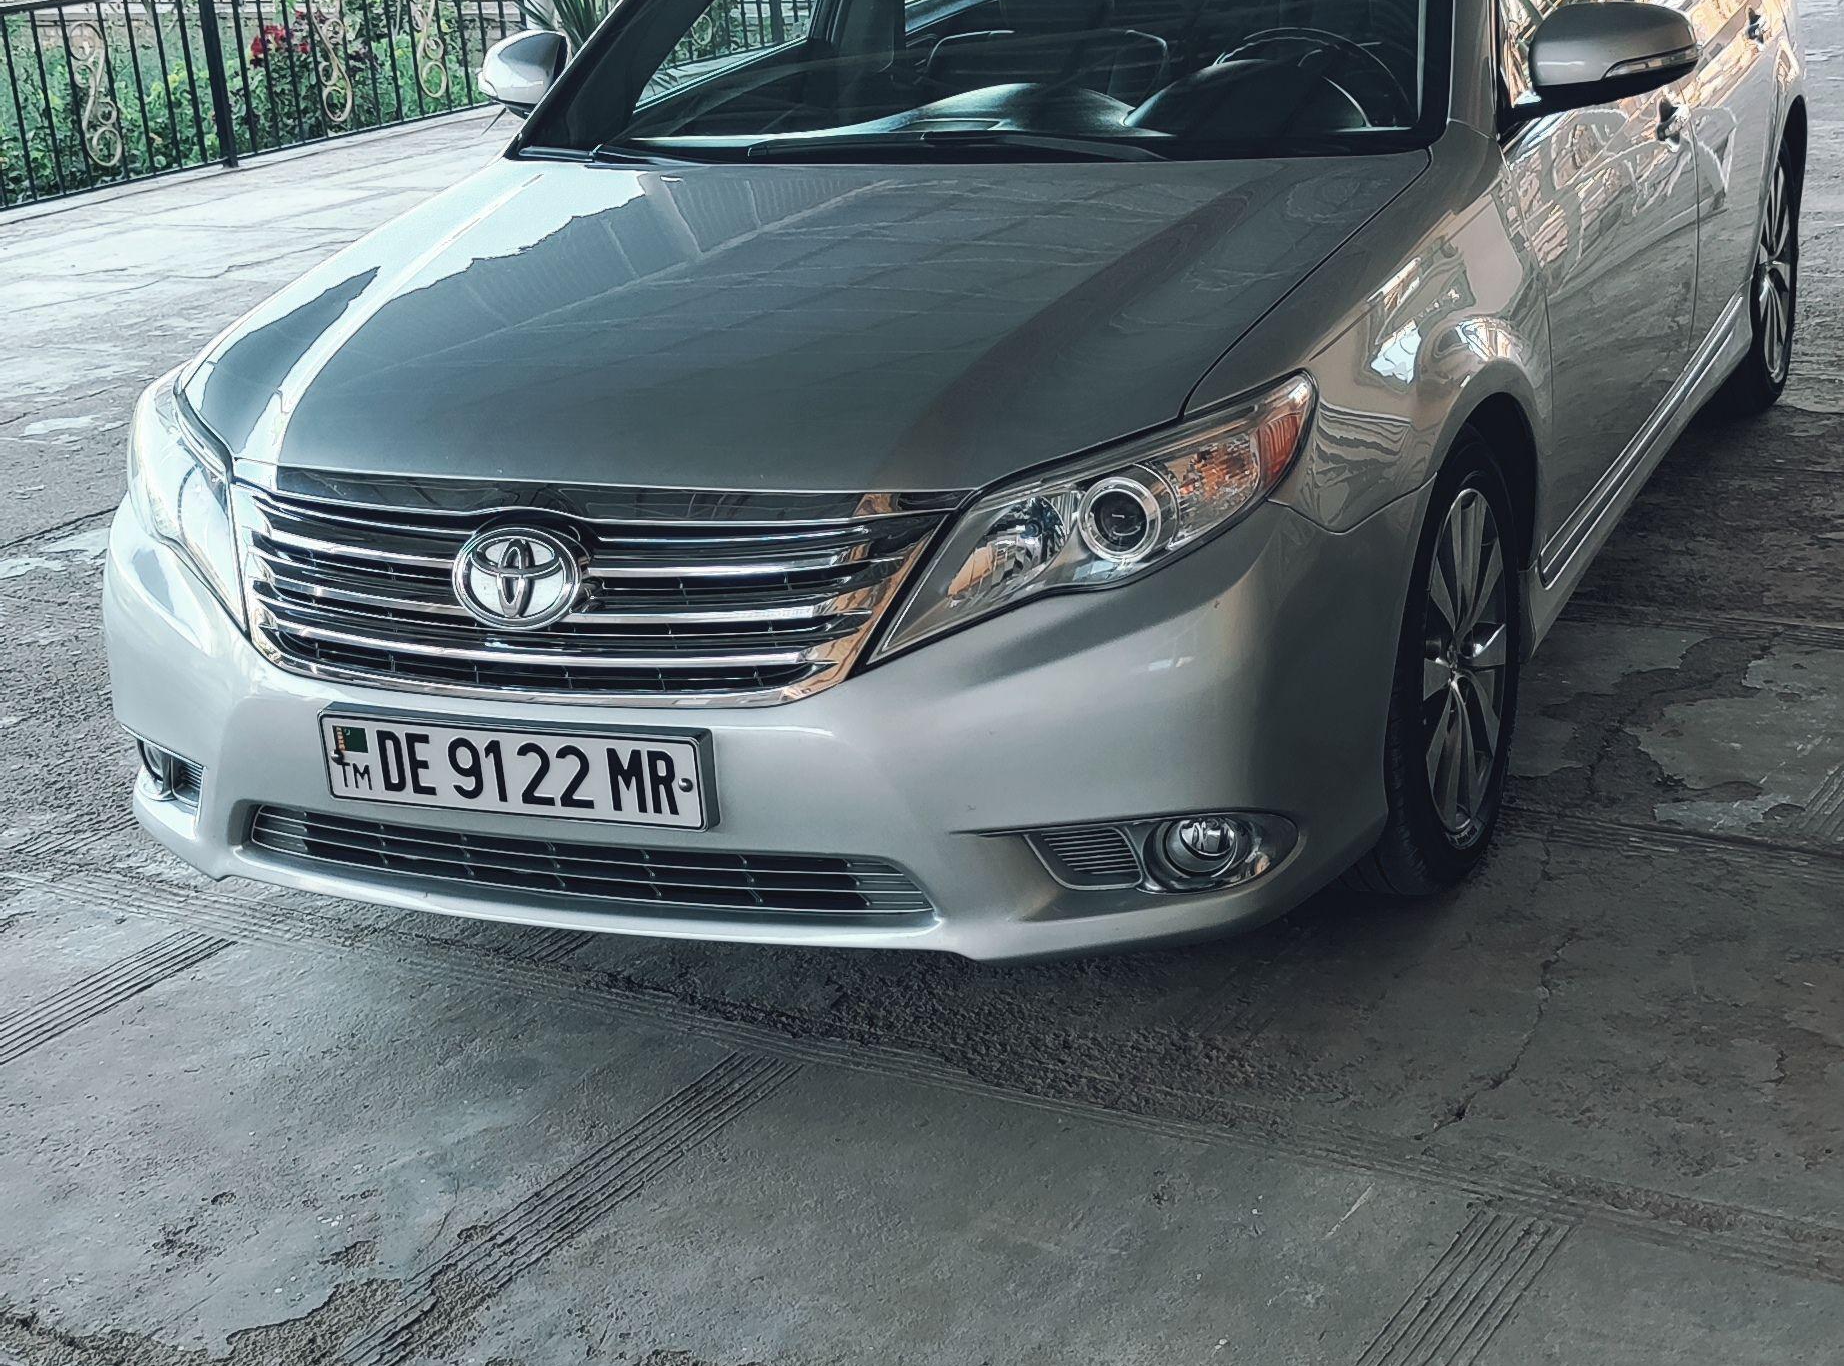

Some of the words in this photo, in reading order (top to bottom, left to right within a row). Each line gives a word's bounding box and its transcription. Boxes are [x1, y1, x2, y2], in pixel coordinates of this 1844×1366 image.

[339, 763, 374, 790] TM
[376, 729, 437, 796] DE
[447, 736, 595, 810] 9122
[606, 747, 680, 816] MR
